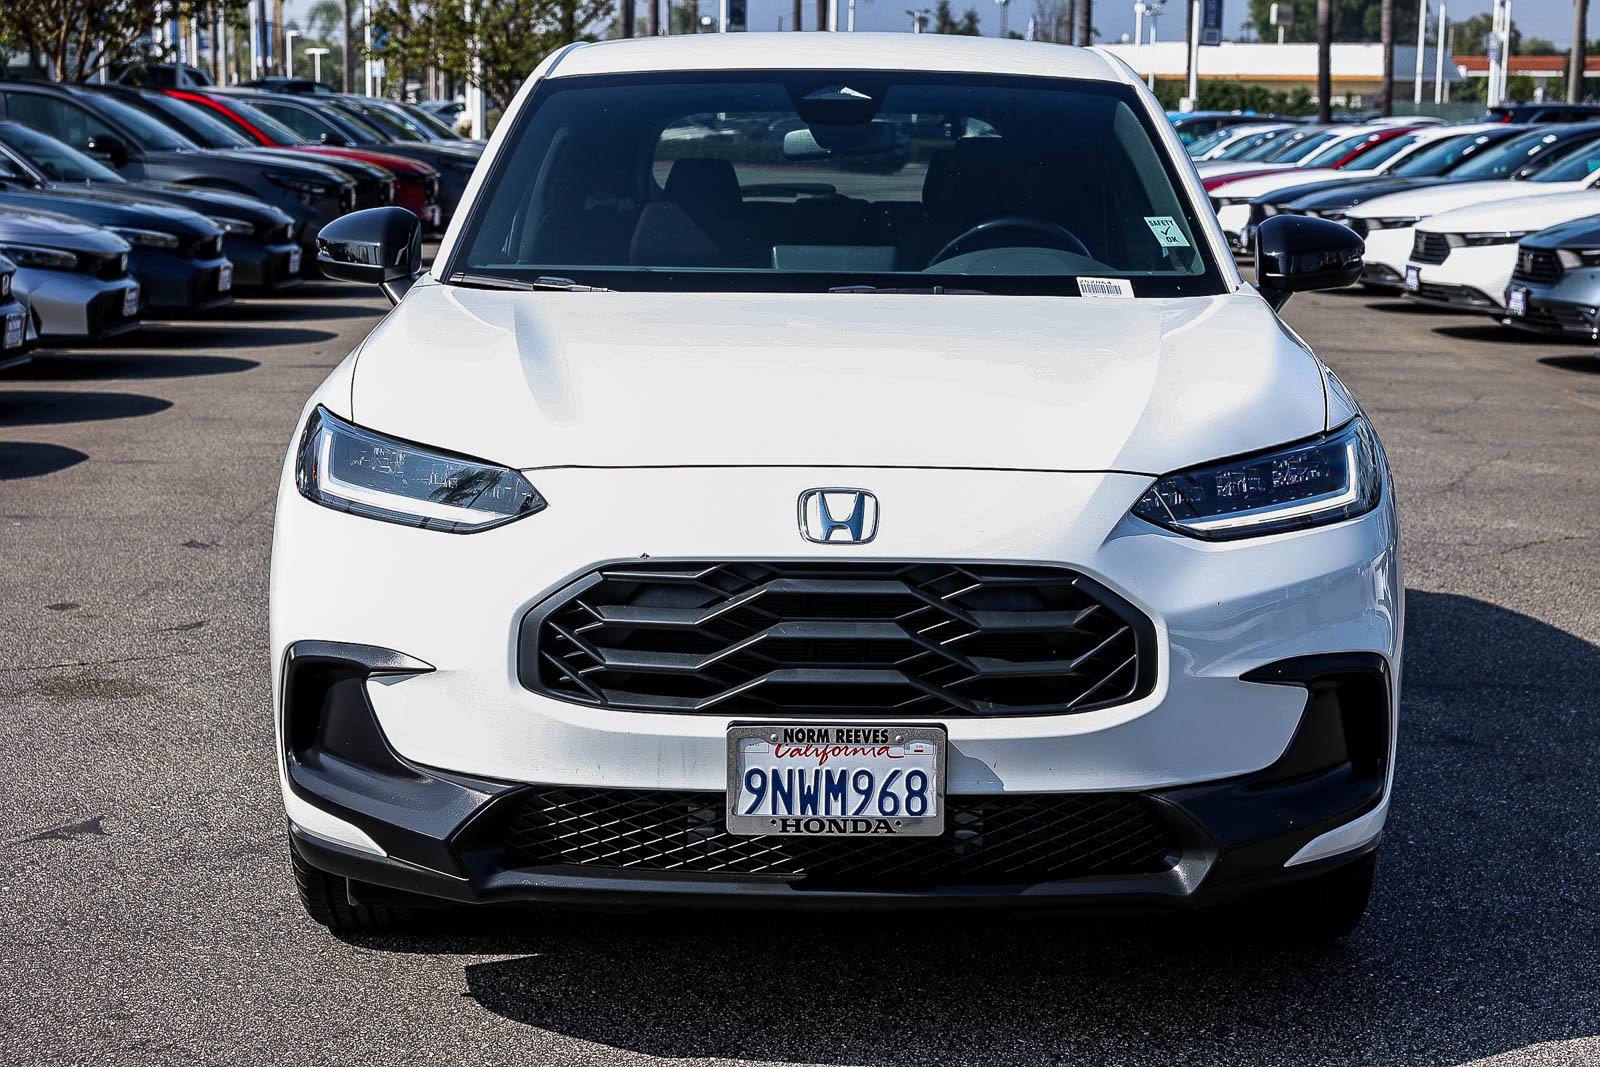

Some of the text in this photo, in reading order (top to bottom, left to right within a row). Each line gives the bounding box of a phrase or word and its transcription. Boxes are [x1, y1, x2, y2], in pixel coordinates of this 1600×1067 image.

[1148, 219, 1174, 227] SAFETY
[783, 728, 889, 744] NORM REEVES
[775, 744, 905, 766] California
[743, 767, 929, 817] 9NWM968
[776, 818, 896, 834] HONDA
